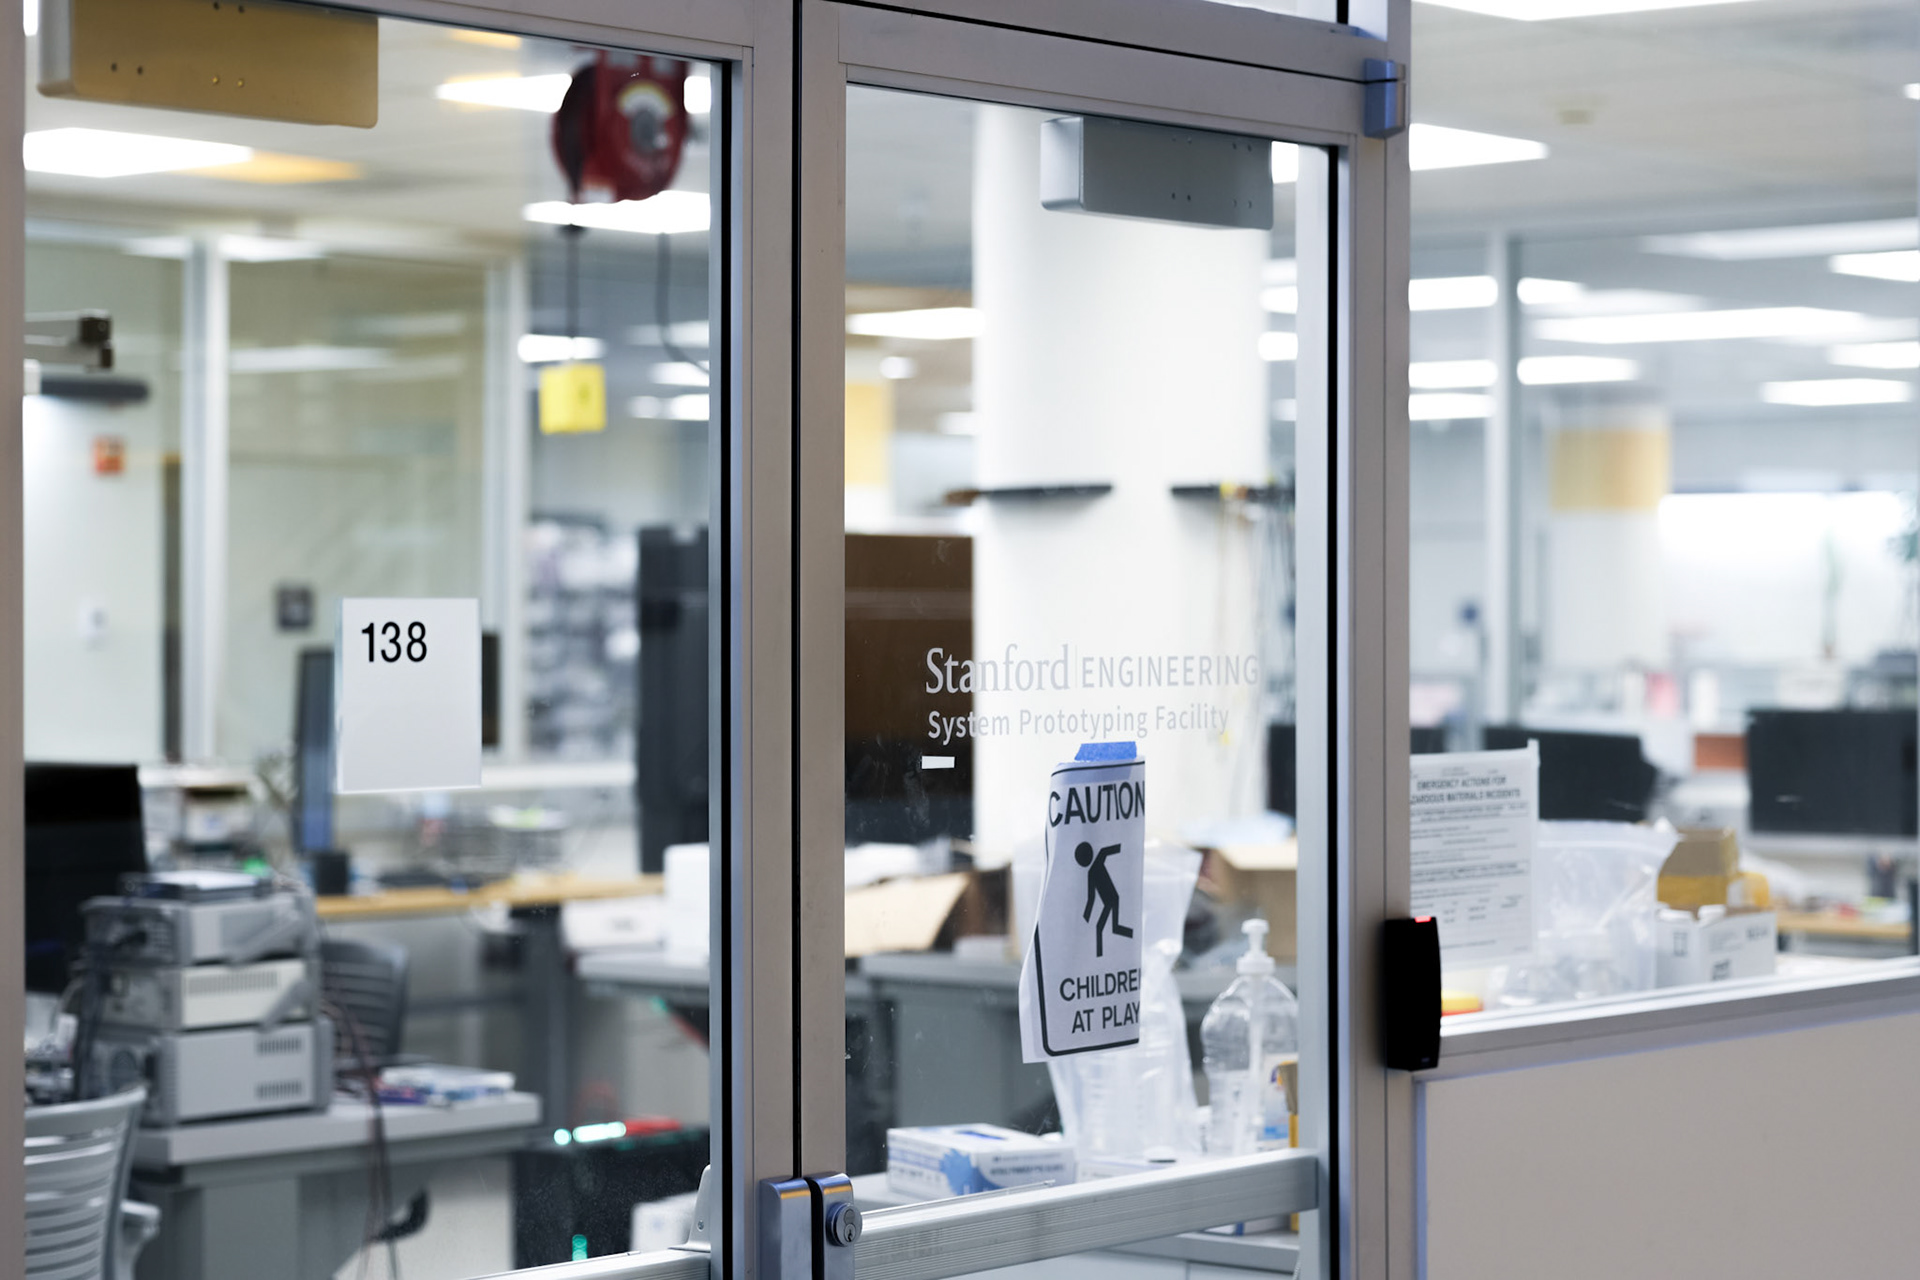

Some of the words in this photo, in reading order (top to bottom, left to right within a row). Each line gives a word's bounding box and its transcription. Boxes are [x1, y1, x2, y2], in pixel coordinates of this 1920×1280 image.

[362, 621, 427, 663] 138
[925, 643, 1070, 694] Stanford
[1082, 654, 1259, 688] ENGINEERING
[928, 710, 1010, 746] System
[1019, 705, 1148, 740] Prototyping
[1156, 703, 1229, 735] Facility
[1049, 780, 1144, 828] CAUTION
[1417, 779, 1459, 791] EMERGENCY
[1072, 1008, 1094, 1034] AT
[1102, 1000, 1140, 1029] PLAY
